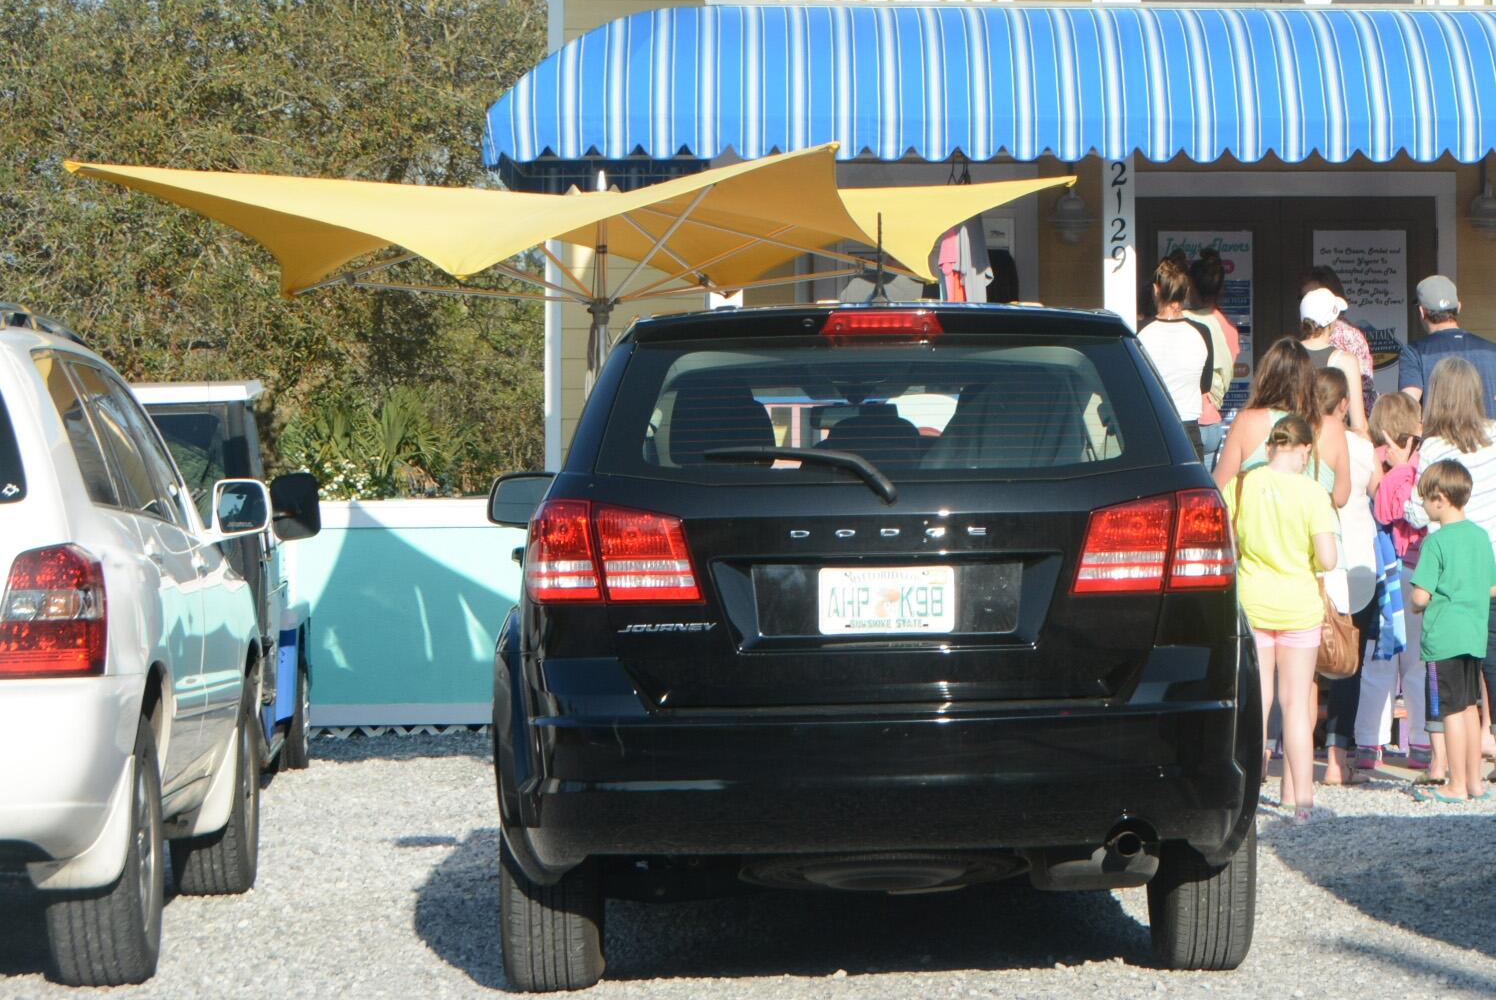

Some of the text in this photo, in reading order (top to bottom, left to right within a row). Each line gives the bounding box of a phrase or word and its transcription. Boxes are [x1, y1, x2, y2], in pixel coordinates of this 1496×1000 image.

[1111, 162, 1128, 273] 2129
[790, 526, 988, 539] DODGE
[901, 587, 944, 617] K98
[617, 622, 718, 634] JOURNEY
[896, 619, 923, 629] STATE
